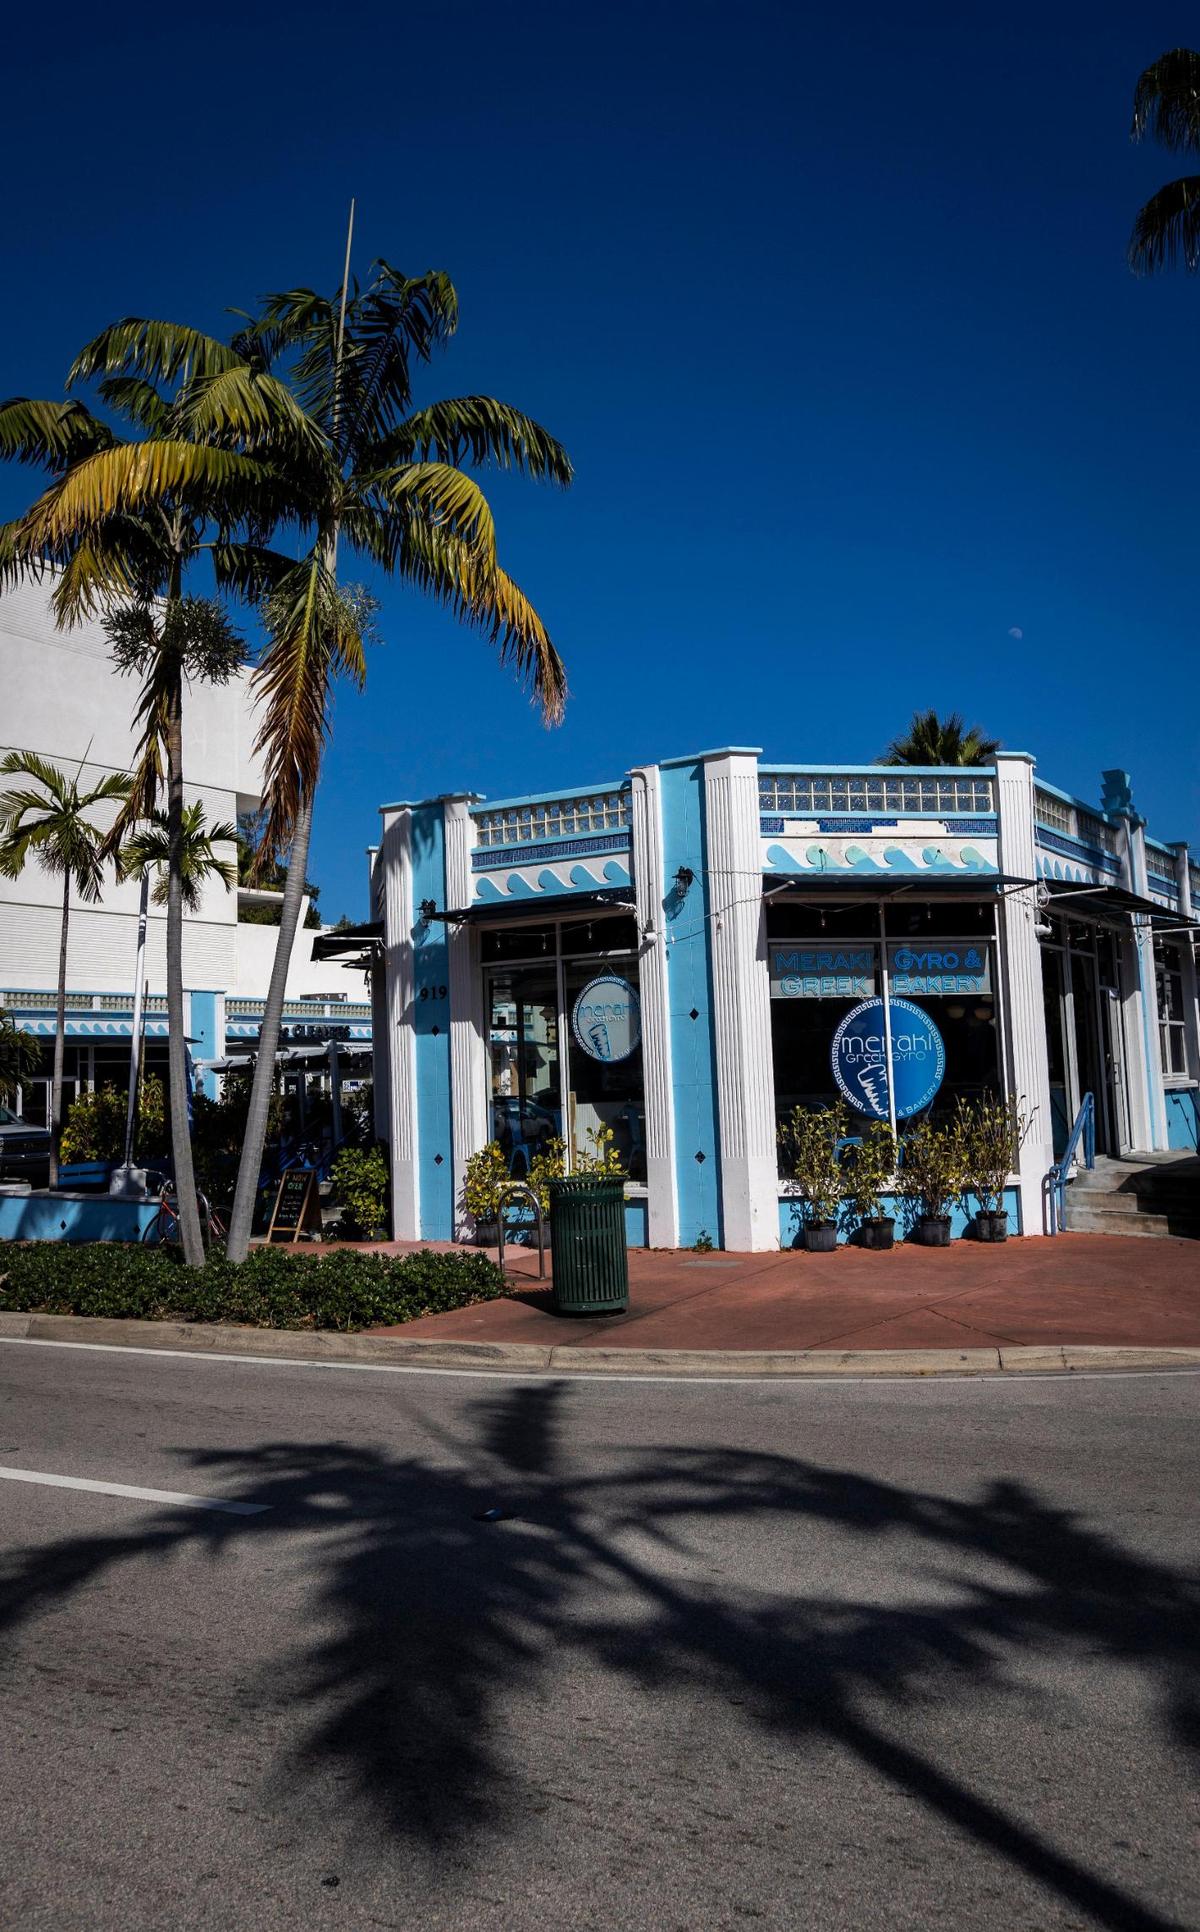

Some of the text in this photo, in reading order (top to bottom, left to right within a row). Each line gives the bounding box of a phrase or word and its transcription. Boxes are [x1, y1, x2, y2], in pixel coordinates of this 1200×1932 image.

[776, 952, 872, 972] MERAKI
[894, 949, 982, 971] GYRO &
[420, 986, 447, 1001] 919
[780, 975, 868, 997] GREEK
[892, 974, 985, 995] BAKERY
[906, 1082, 936, 1114] BAKERY
